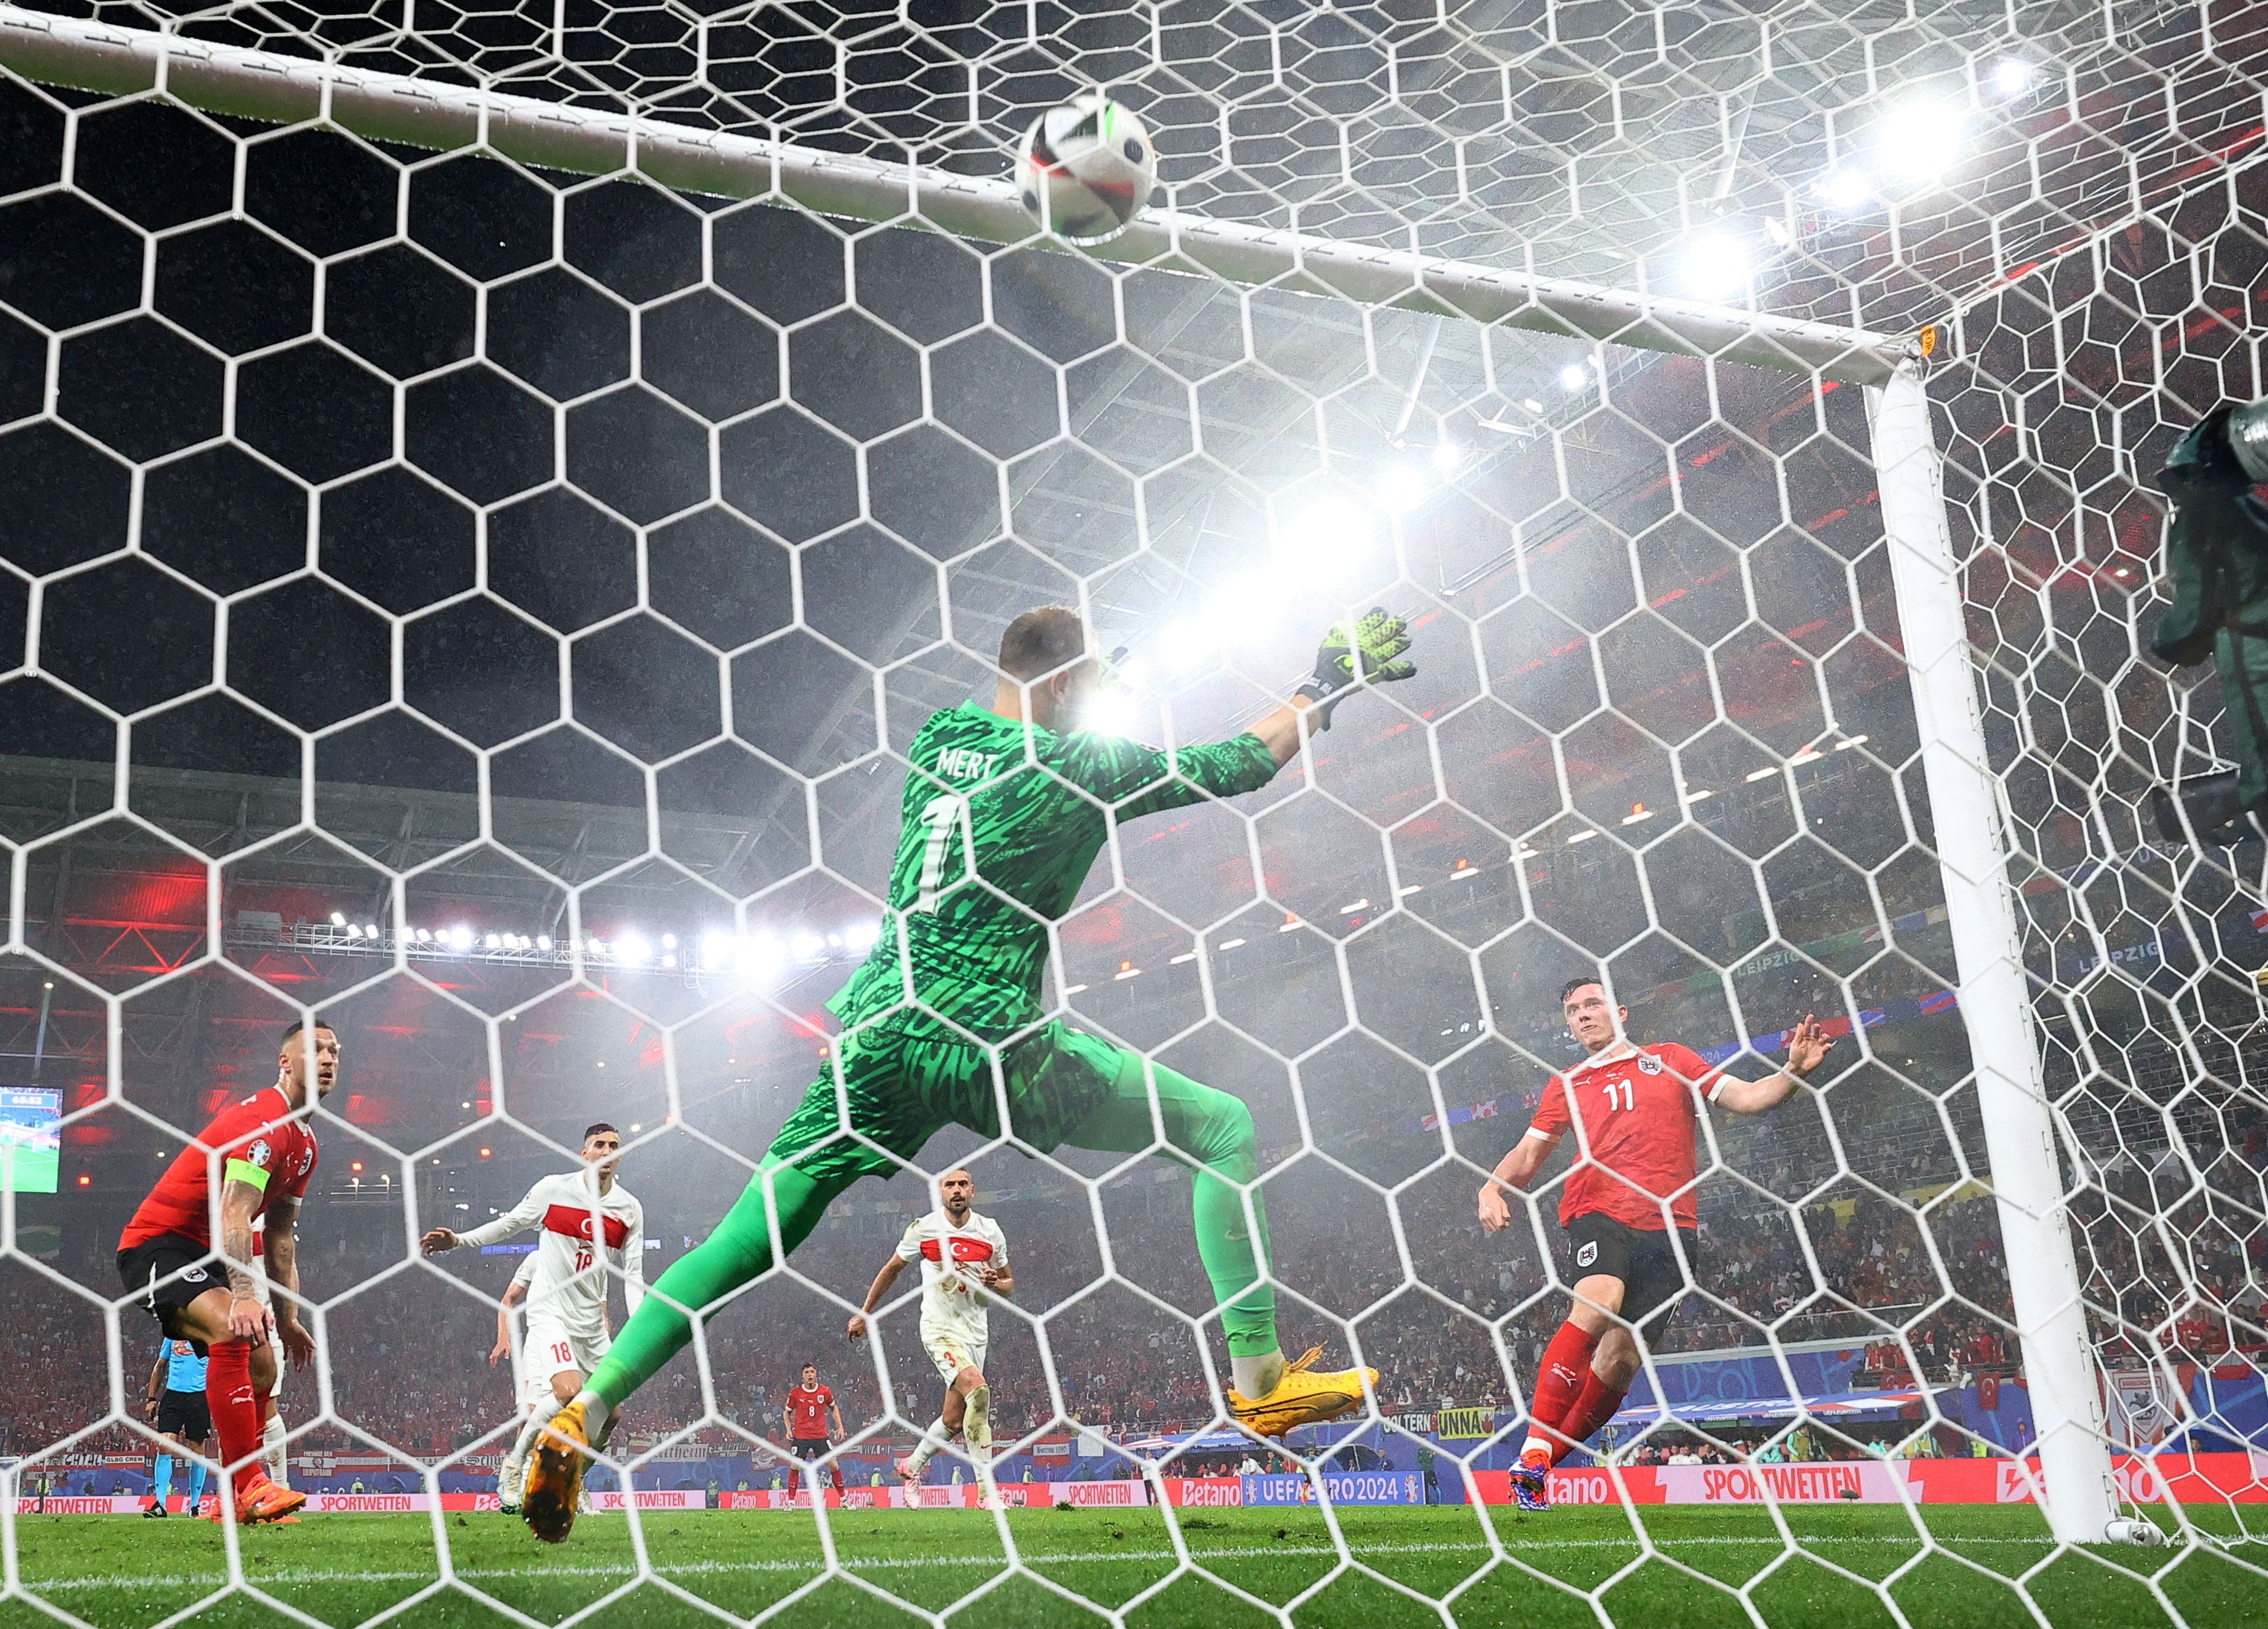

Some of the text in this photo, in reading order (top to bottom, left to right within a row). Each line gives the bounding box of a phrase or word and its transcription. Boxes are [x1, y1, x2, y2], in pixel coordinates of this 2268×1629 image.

[935, 746, 999, 780] MERT
[919, 795, 962, 916] 1
[1737, 951, 1800, 977] LEIPZIG
[2079, 941, 2160, 973] LEPZIG
[1602, 1079, 1634, 1111] 11
[576, 1251, 592, 1273] 18
[550, 1341, 572, 1363] 18
[943, 1351, 956, 1367] 3
[808, 1405, 816, 1417] 8
[1439, 1411, 1481, 1436] UNNA
[655, 1446, 706, 1459] ltheim
[779, 1491, 812, 1506] SPOWETTE
[1000, 1486, 1027, 1507] tano
[1069, 1483, 1132, 1504] SPORTWETTEN
[1182, 1481, 1241, 1506] Betano
[1263, 1477, 1399, 1501] UEFA ERO 2024
[1546, 1473, 1607, 1504] tano
[321, 1496, 411, 1511] SPORTWETTEN
[604, 1493, 685, 1508] SPOTWETTEN
[732, 1492, 756, 1508] Betano
